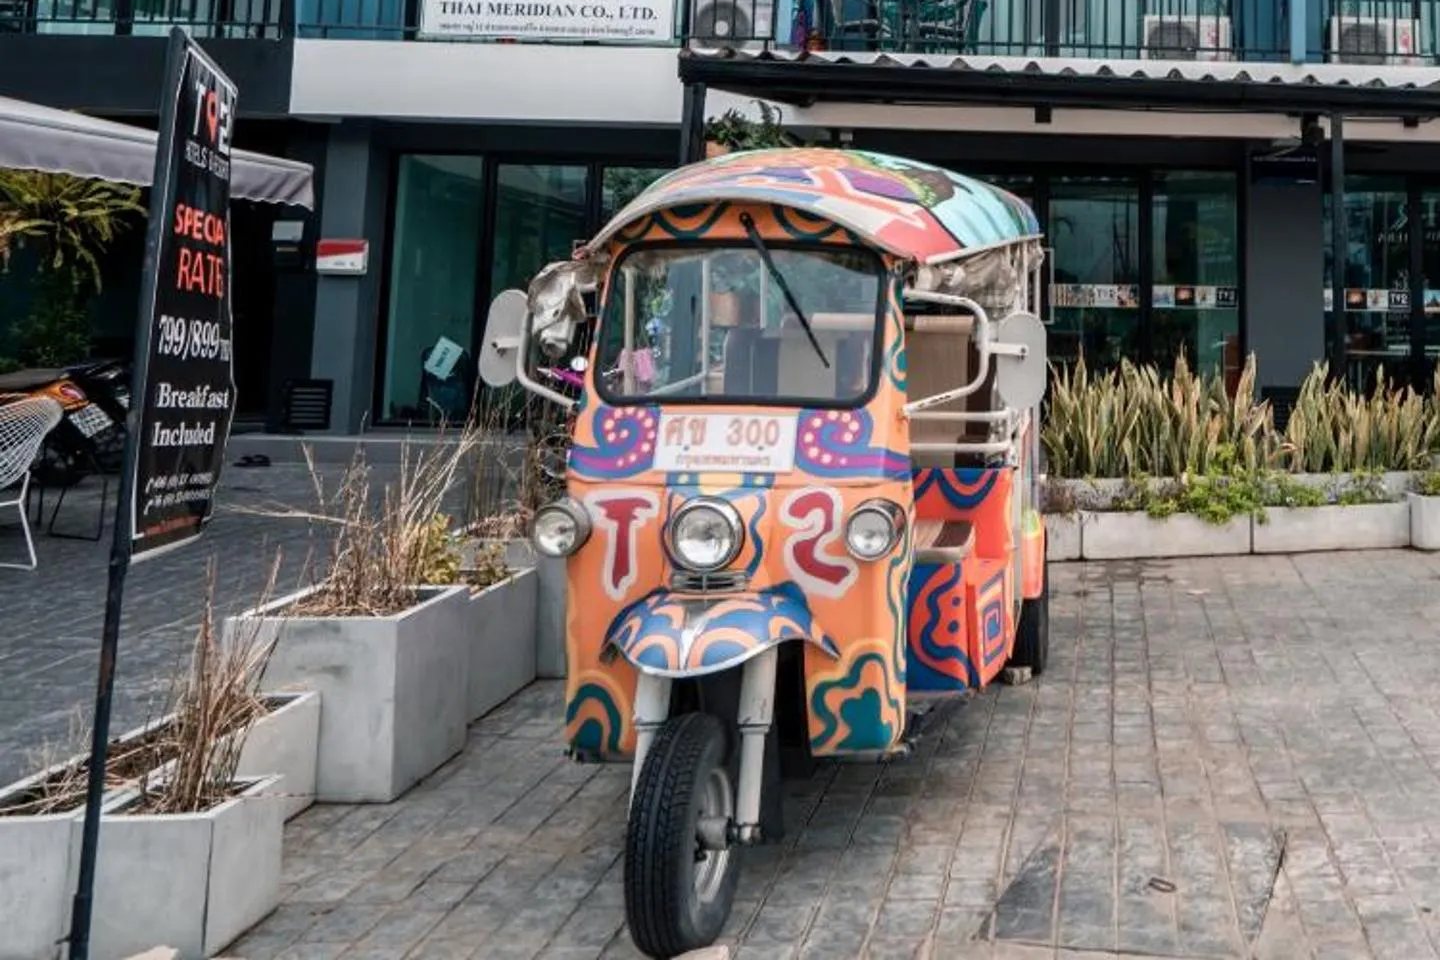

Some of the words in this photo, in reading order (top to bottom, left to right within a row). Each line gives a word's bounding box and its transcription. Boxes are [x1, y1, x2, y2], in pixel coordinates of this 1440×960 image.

[440, 1, 482, 16] THAI
[486, 2, 576, 18] MERIDIAN
[618, 5, 659, 20] LTD.
[174, 203, 226, 246] SPECIA
[158, 314, 220, 361] 799/899
[156, 381, 229, 409] Breakfast
[152, 421, 216, 447] Included
[725, 417, 780, 447] 300
